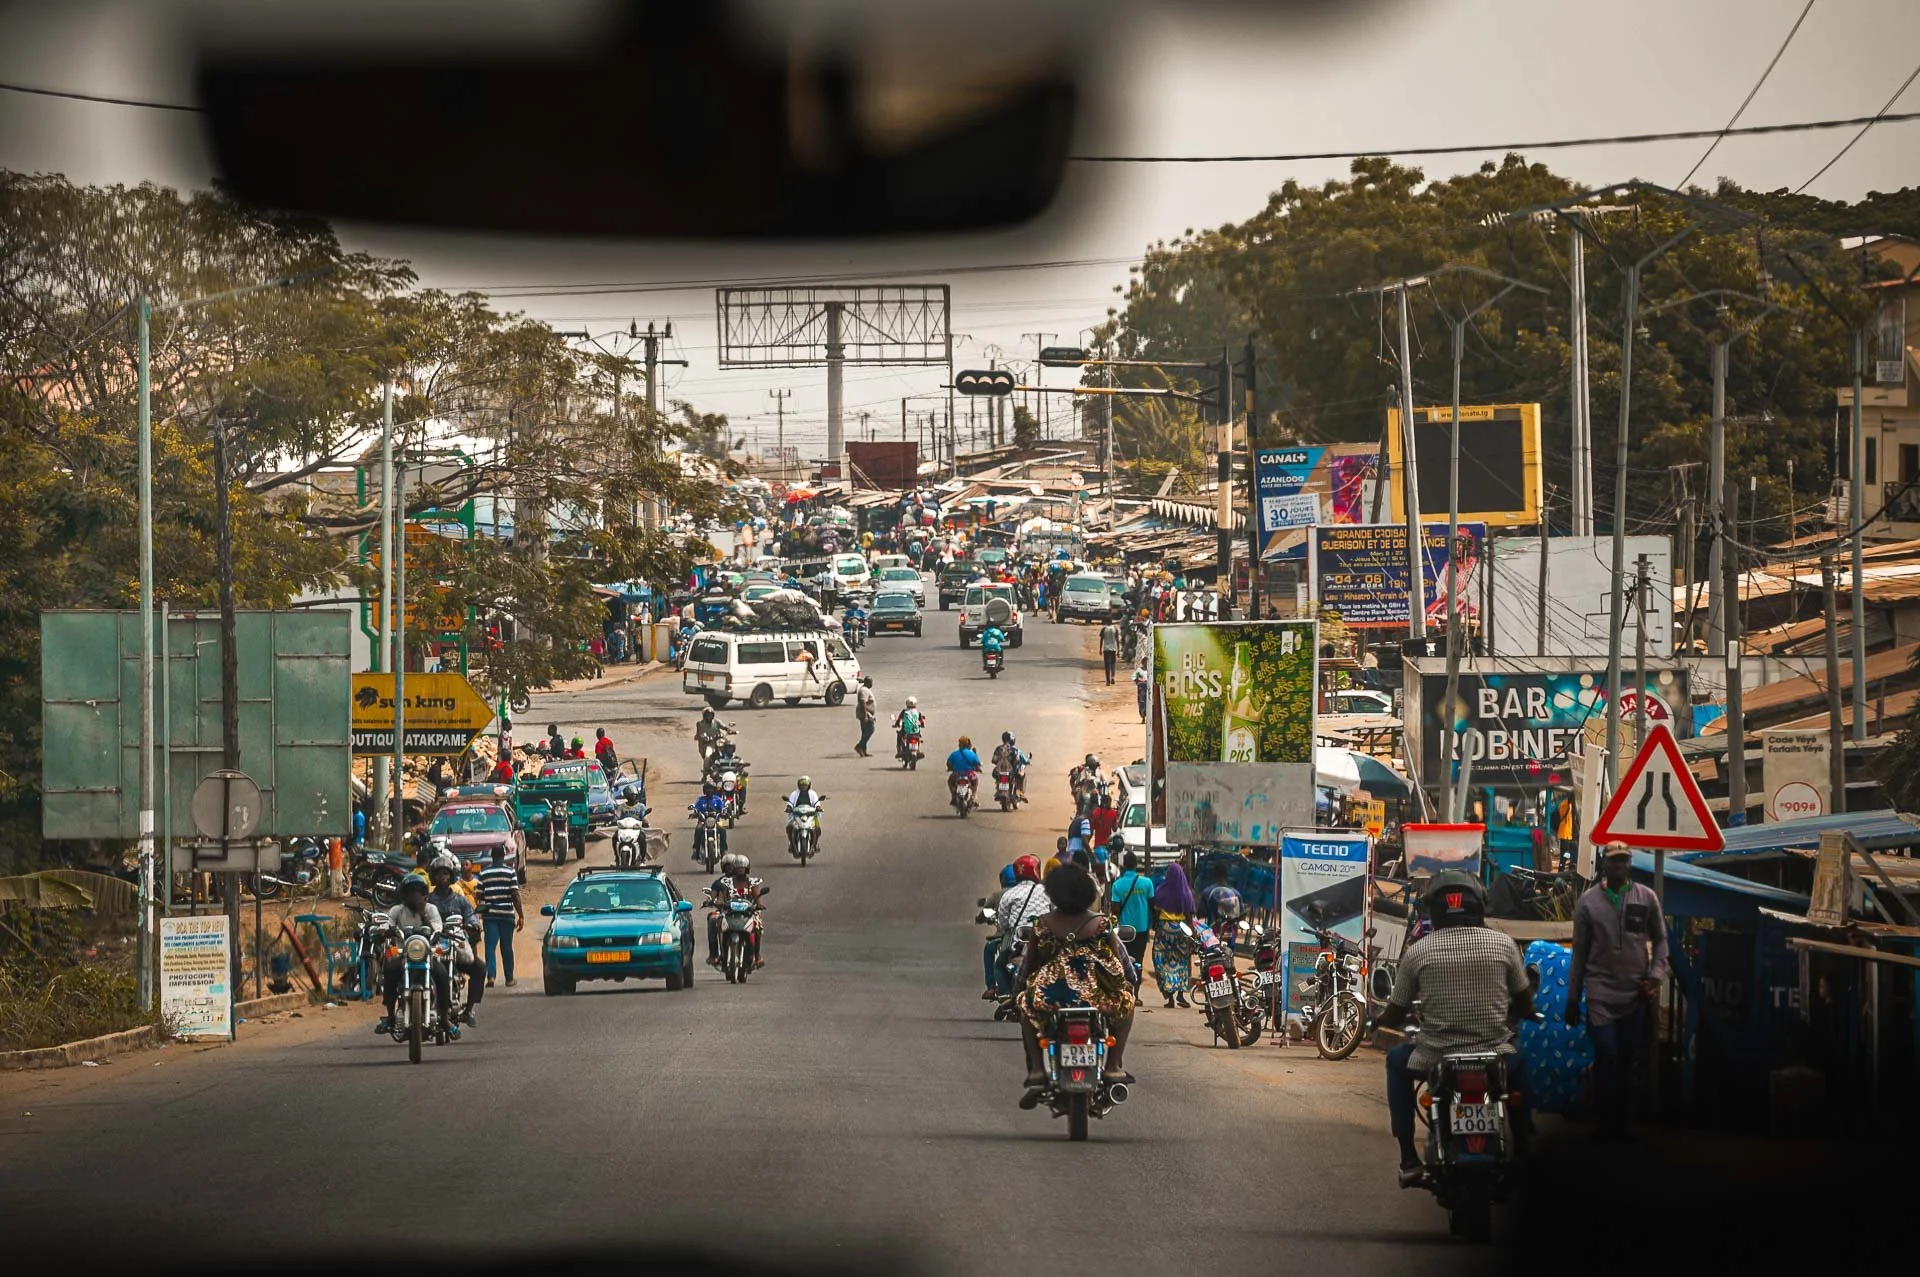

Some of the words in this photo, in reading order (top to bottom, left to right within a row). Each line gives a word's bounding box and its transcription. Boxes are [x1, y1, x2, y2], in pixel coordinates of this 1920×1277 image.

[1260, 453, 1307, 464] CANAL+
[1270, 508, 1288, 520] 30
[1337, 530, 1372, 539] GRANDE
[1374, 528, 1407, 538] CROISA
[1321, 540, 1365, 550] GUERISON
[1367, 540, 1378, 549] ET
[1335, 576, 1352, 584] 04
[1365, 575, 1382, 584] 06
[1183, 652, 1205, 670] BIG
[1166, 670, 1222, 699] BOSS
[415, 695, 456, 712] king
[1478, 686, 1548, 720] BAR
[1183, 702, 1206, 717] PILS
[404, 734, 467, 747] ATAKPAME
[1768, 736, 1794, 744] Code
[1768, 744, 1802, 753] Forfaits
[1230, 749, 1252, 762] PILS
[554, 766, 586, 774] TOYOTA
[1302, 842, 1350, 857] TECNO
[1300, 862, 1337, 872] CAMON
[1464, 1106, 1485, 1118] DK
[1453, 1120, 1498, 1132] 1001
